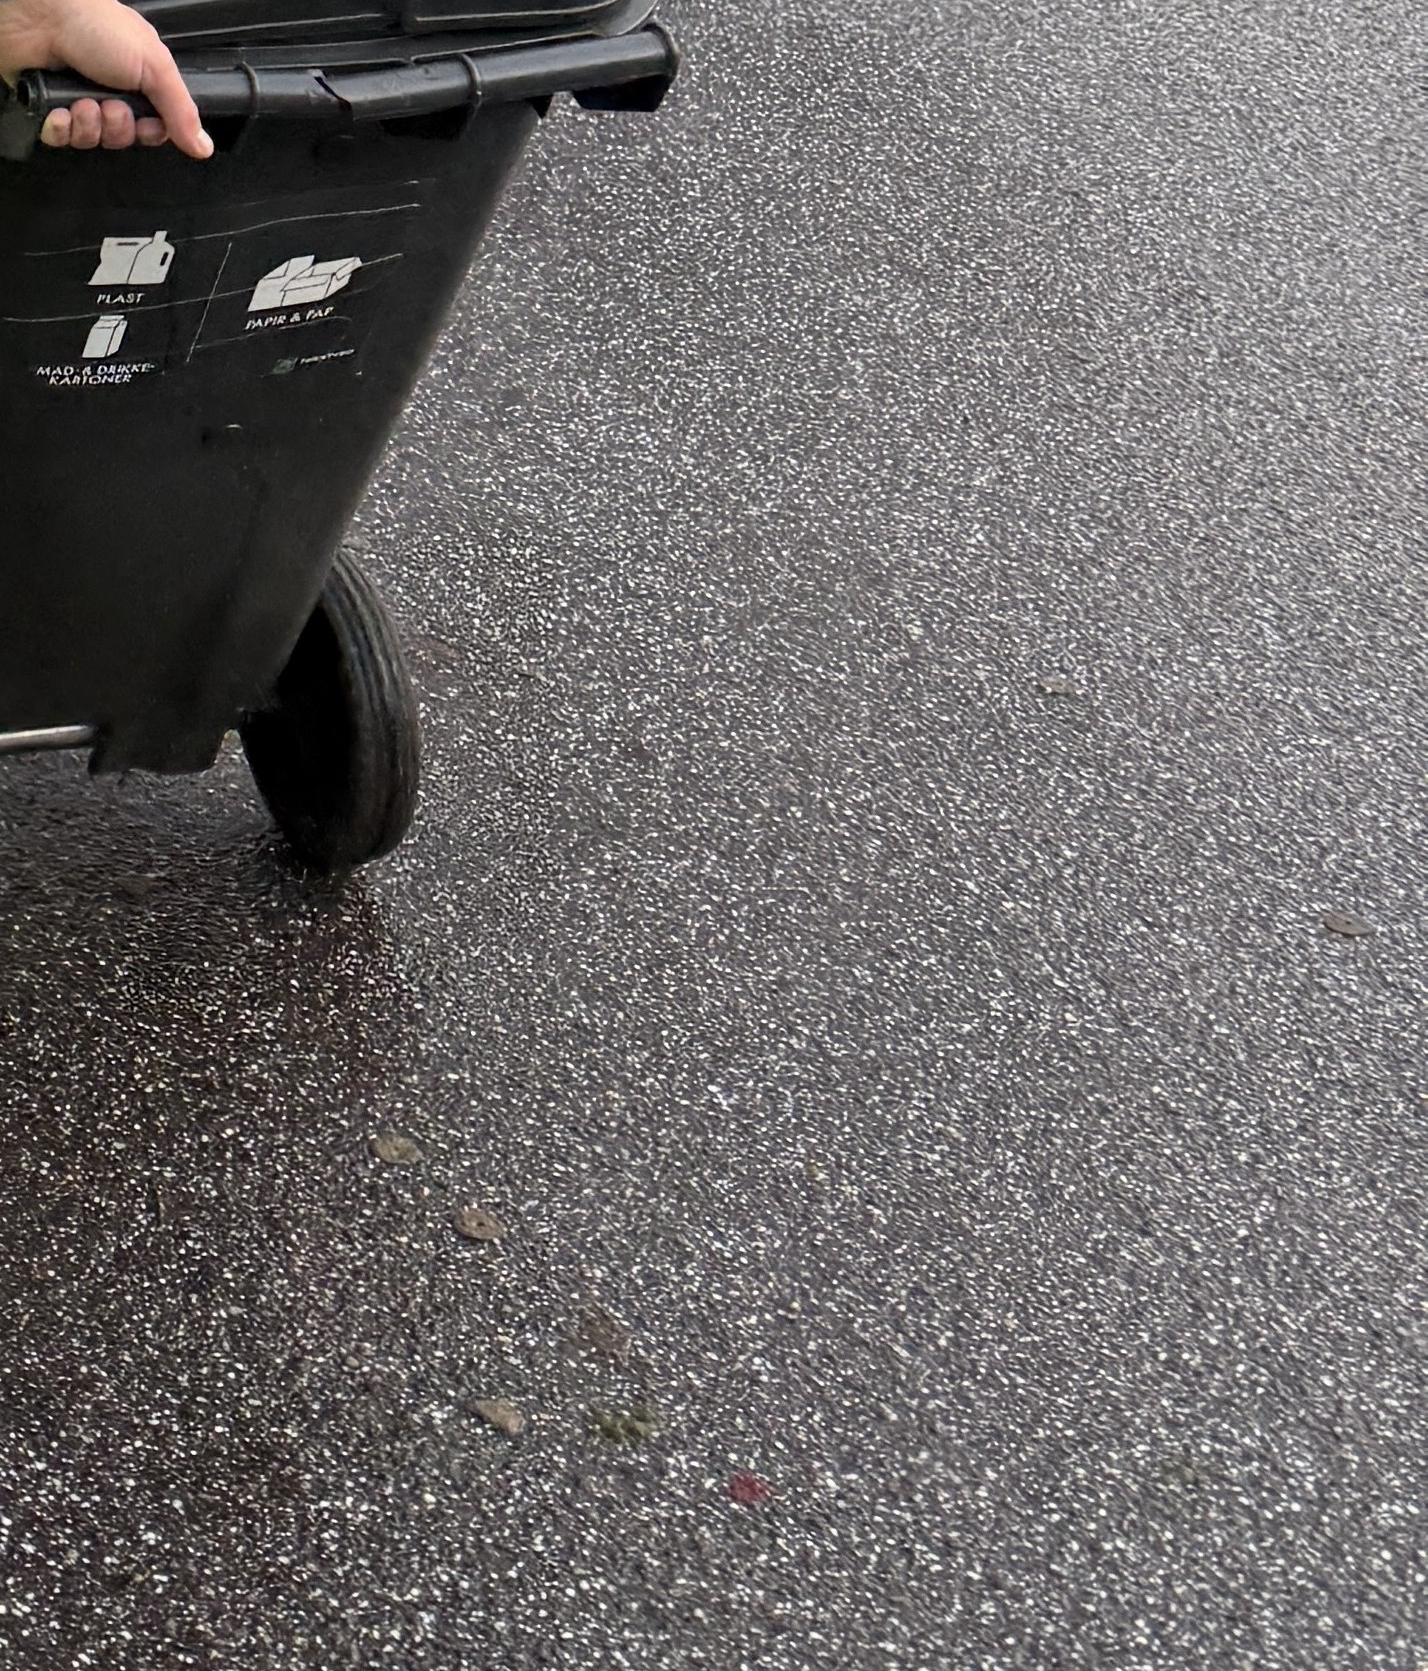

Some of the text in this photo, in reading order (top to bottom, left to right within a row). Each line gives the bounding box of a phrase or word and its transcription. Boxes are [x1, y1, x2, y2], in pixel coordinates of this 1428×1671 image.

[96, 292, 145, 304] PLAST
[244, 306, 335, 331] PAPIR & PAP
